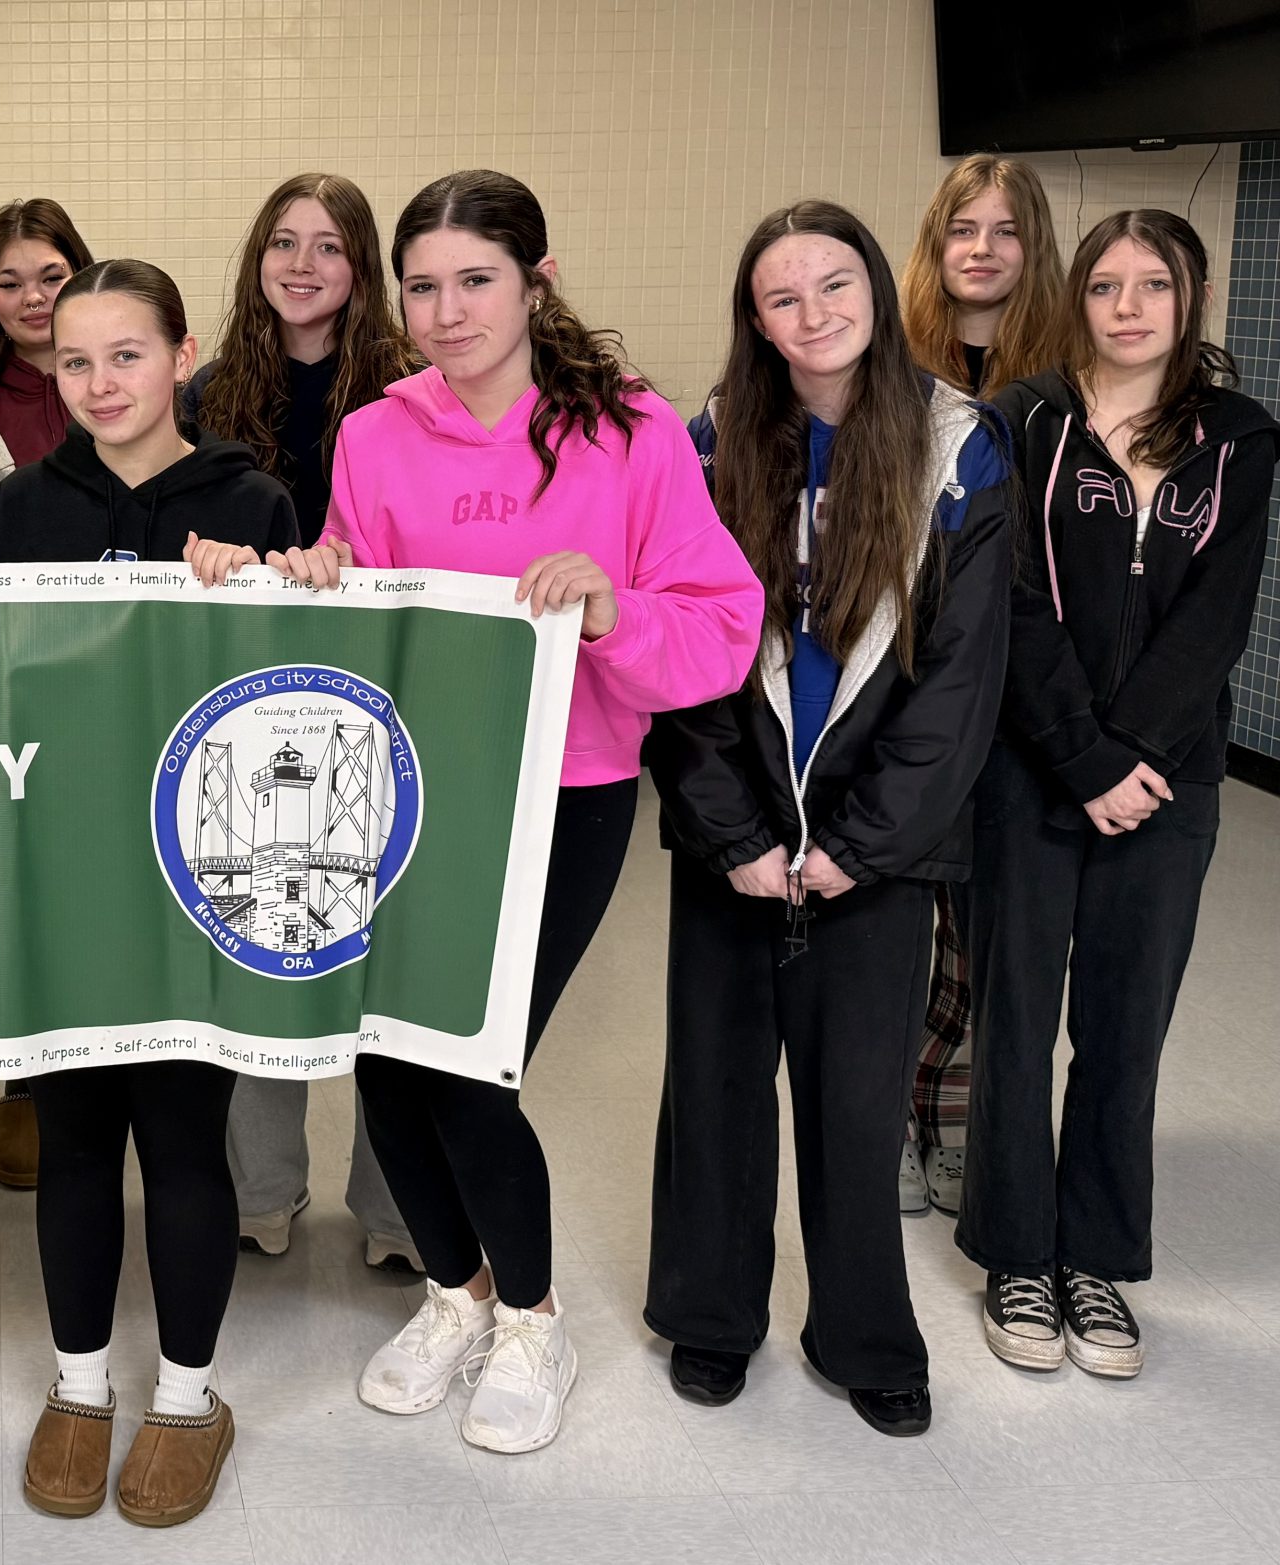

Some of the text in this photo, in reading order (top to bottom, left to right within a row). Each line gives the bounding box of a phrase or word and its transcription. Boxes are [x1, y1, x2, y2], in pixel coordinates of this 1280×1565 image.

[452, 491, 518, 525] GAP
[36, 572, 105, 587] Gratitude
[130, 572, 187, 589] Humility
[211, 577, 257, 588] umor
[374, 579, 426, 593] Kindness
[165, 679, 267, 773] Ogdensburg
[271, 671, 316, 686] City
[318, 673, 388, 713] School
[254, 706, 343, 718] Guiding Children
[270, 725, 327, 735] Since 1868
[194, 901, 241, 953] Kennedy
[282, 956, 314, 970] OFA
[41, 1047, 90, 1062] Purpose
[114, 1037, 197, 1053] Self-Control
[219, 1043, 254, 1063] Social
[258, 1053, 338, 1071] Intelligence
